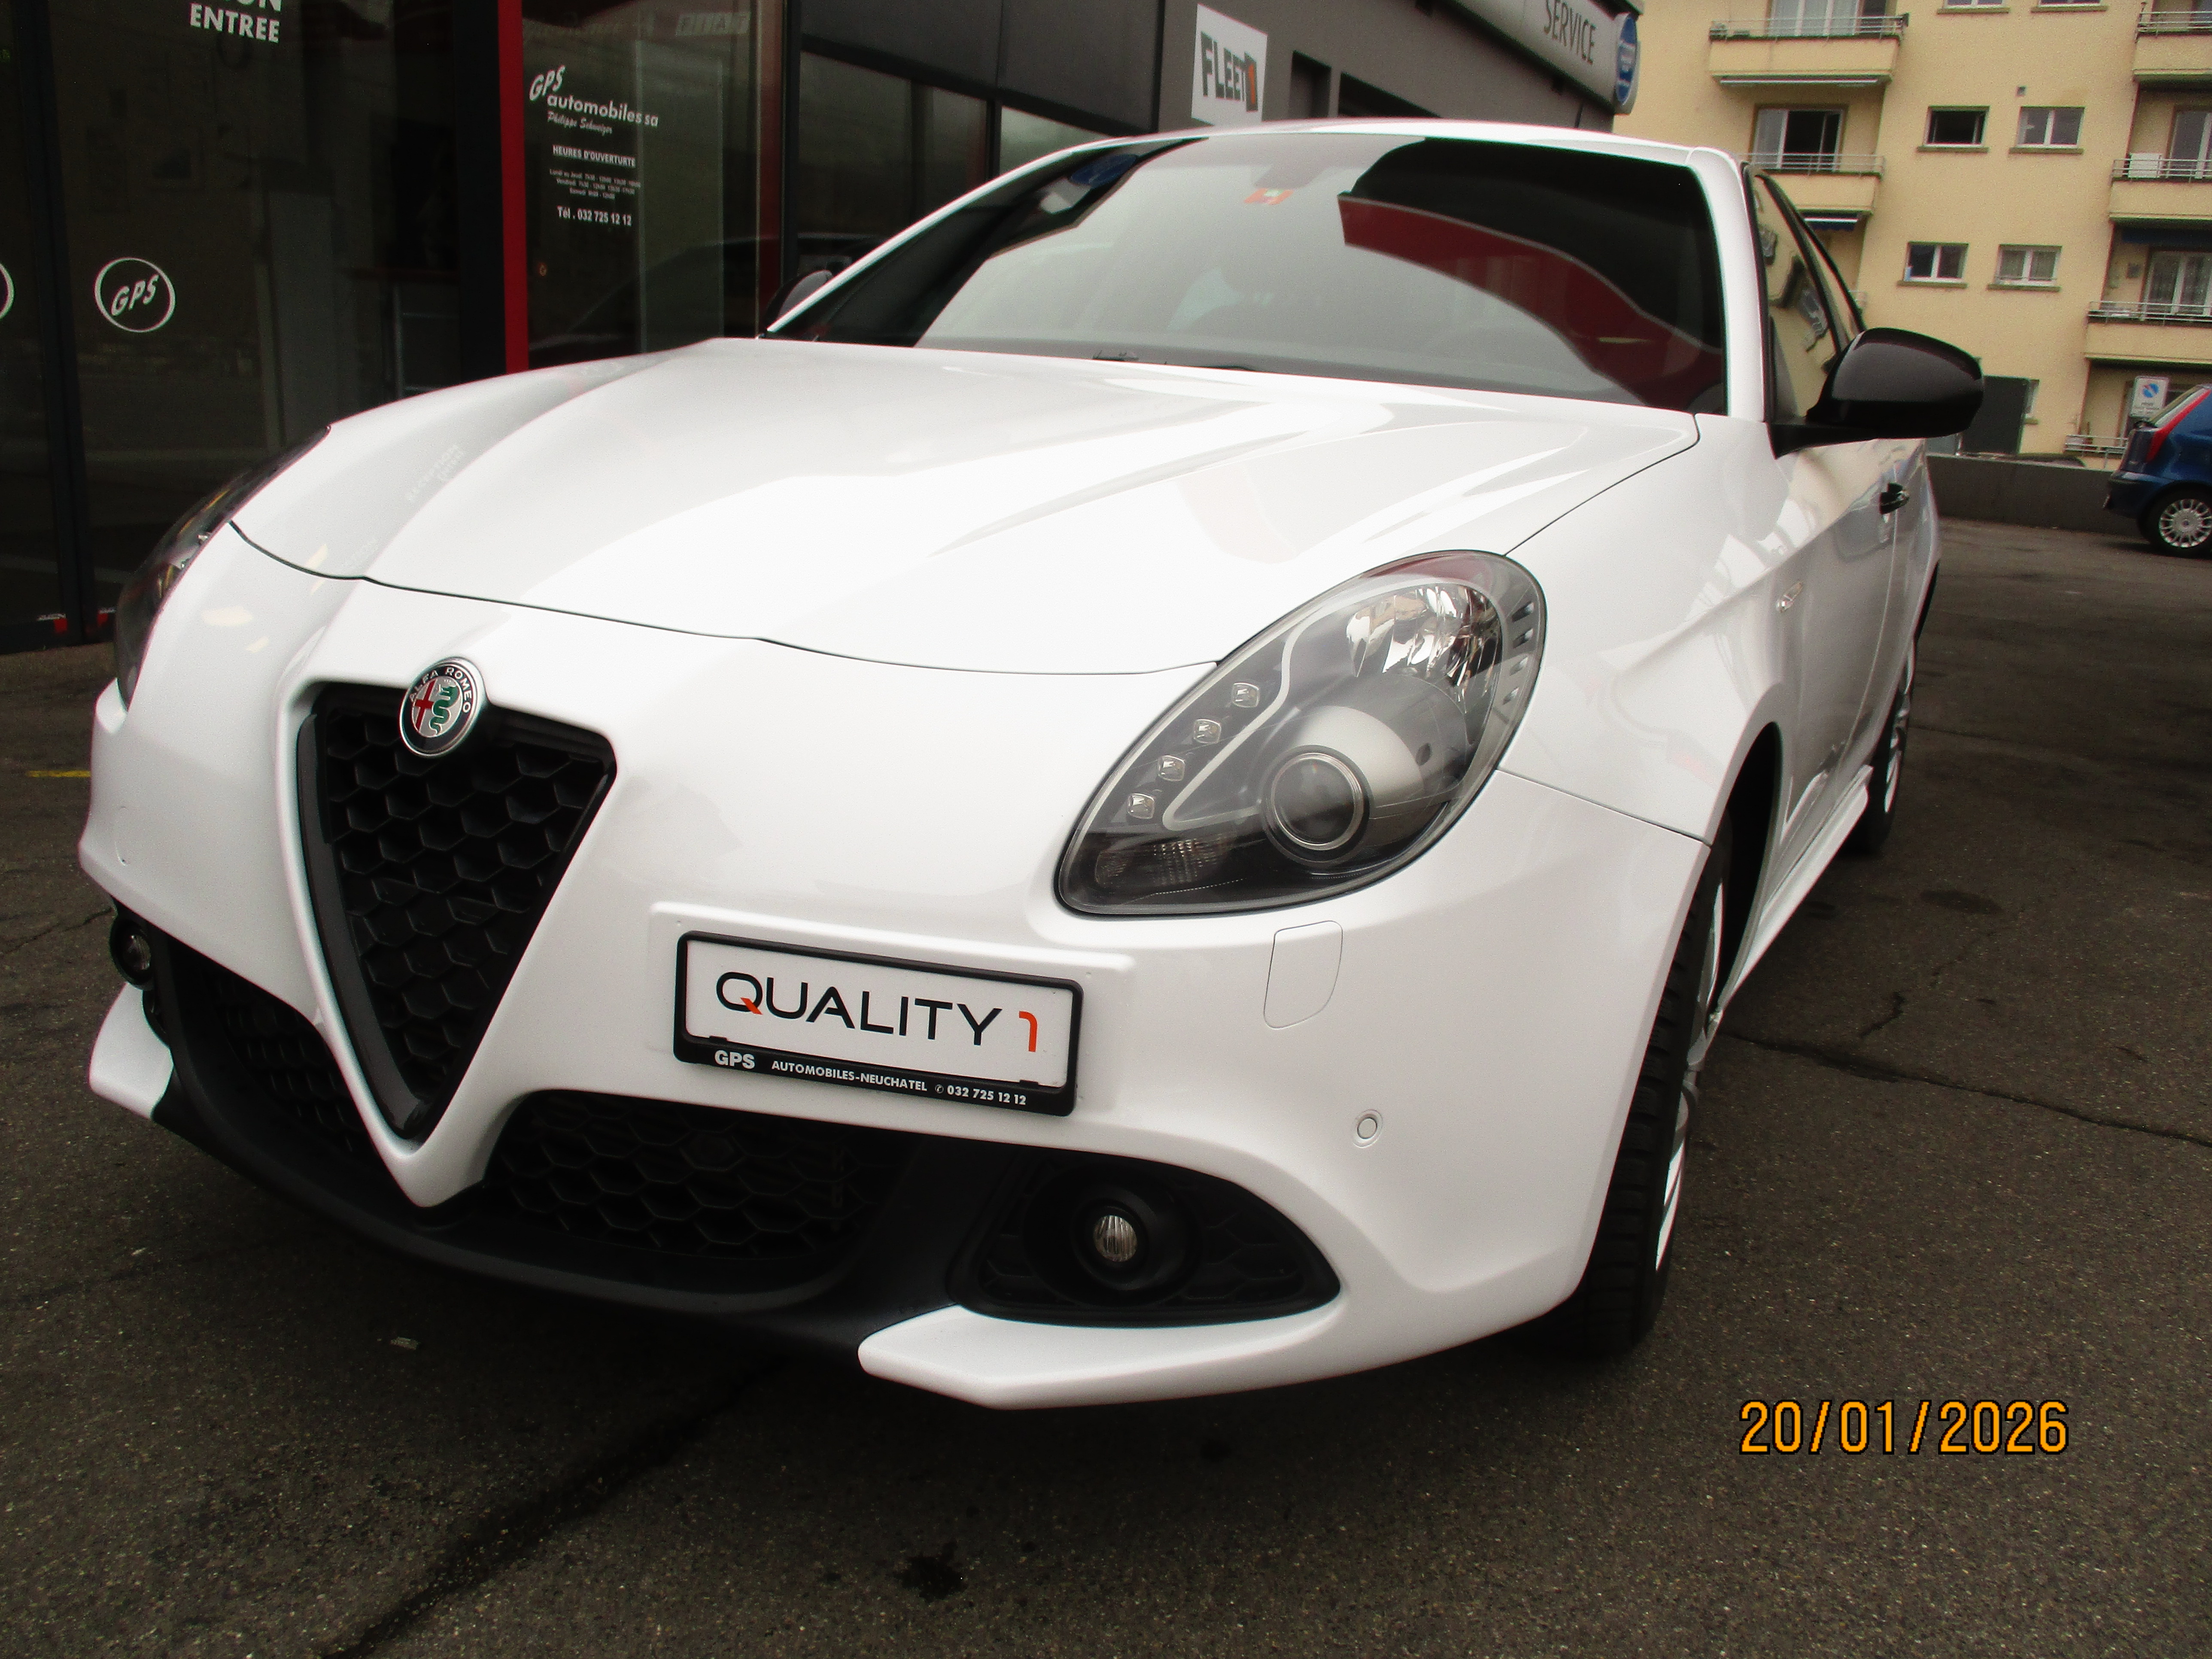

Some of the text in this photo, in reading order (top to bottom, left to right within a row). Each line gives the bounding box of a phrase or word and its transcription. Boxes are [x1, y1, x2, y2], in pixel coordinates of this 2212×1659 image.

[190, 3, 280, 43] ENTREE
[1544, 0, 1596, 64] SERVICE
[529, 65, 565, 100] GPS
[547, 94, 659, 127] automobiles sa
[553, 144, 582, 159] HEURES
[577, 208, 592, 222] 032
[594, 210, 608, 223] 725
[611, 212, 620, 225] 12
[623, 214, 632, 226] 12
[111, 274, 159, 316] GPS
[409, 667, 472, 713] ALFA ROMEO
[716, 972, 1038, 1052] QUALITY 1
[714, 1050, 1026, 1105] GPS AUTOMOBILES-NEUCHATEL 032 725 12 12
